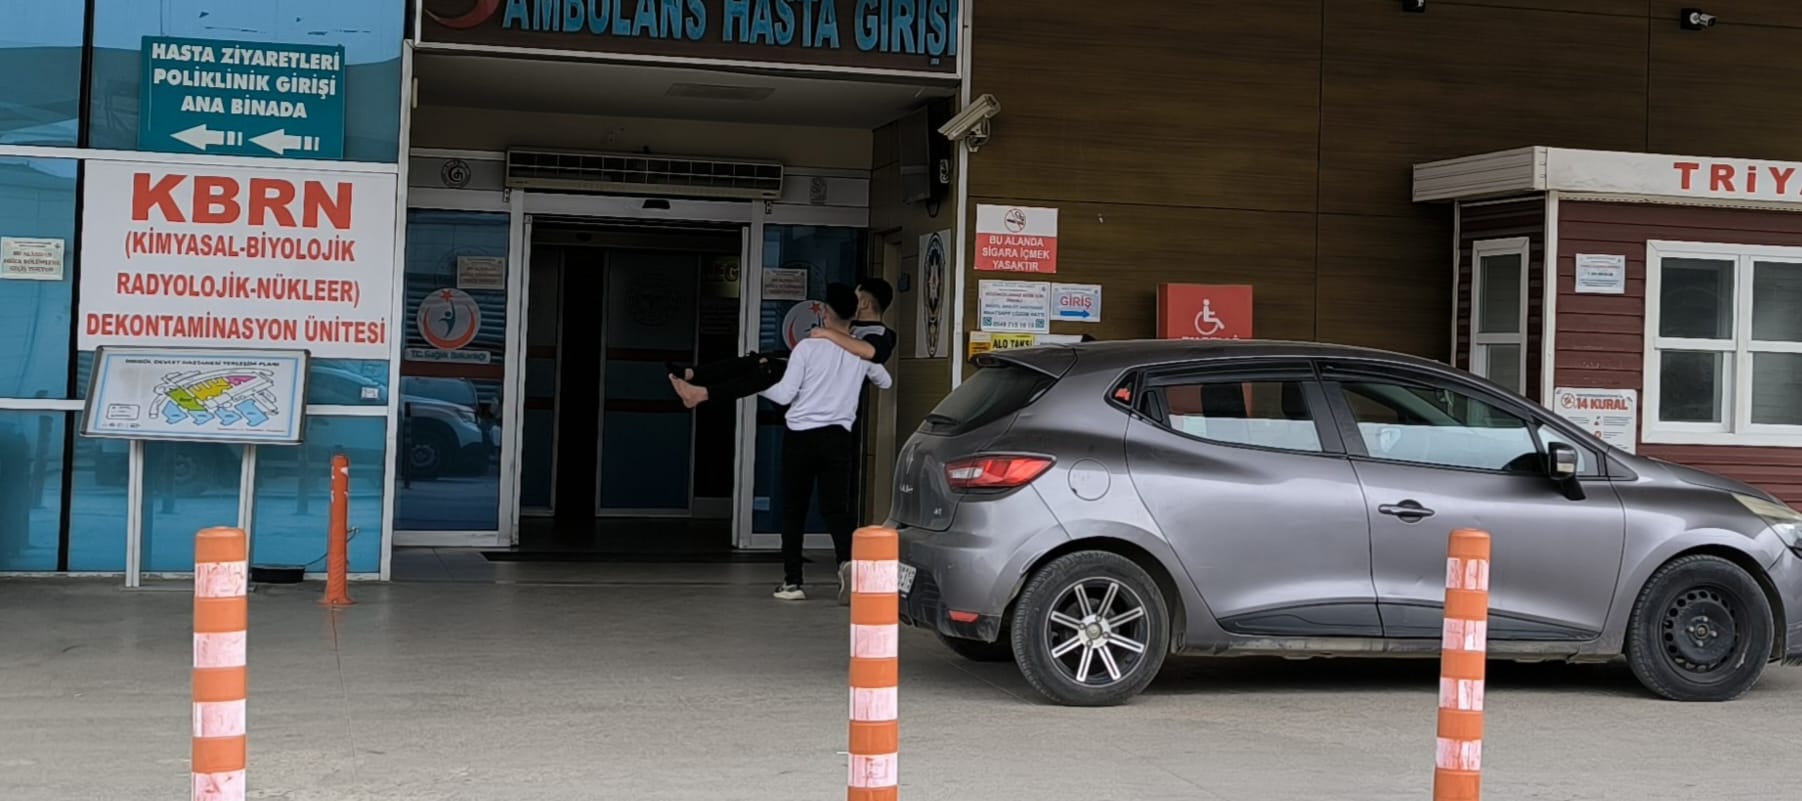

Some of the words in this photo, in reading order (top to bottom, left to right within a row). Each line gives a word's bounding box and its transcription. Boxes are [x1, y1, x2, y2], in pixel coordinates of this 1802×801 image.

[502, 0, 706, 40] AMBULANS
[723, 0, 840, 48] HASTA
[152, 43, 215, 63] HASTA
[220, 44, 340, 71] ZİYARETLERİ
[153, 66, 270, 91] POLİKLİNİK
[276, 73, 336, 99] GİRİŞİ
[181, 96, 225, 114] ANA
[231, 94, 307, 118] BİNADA
[1673, 162, 1802, 195] TRiY
[131, 172, 353, 229] KBRN
[125, 227, 356, 262] (KİMYASAL-BİYOLOJİK
[982, 245, 1018, 258] SİGARA
[1020, 247, 1050, 260] İÇMEK
[989, 235, 1003, 245] BU
[1005, 236, 1044, 247] ALANDA
[992, 260, 1039, 272] YASAKTIR
[117, 271, 360, 308] RADYOLOJİK-NÜKLEER)
[1060, 294, 1092, 309] GİRİŞ
[86, 311, 297, 341] DEKONTAMİNASYON
[304, 315, 386, 344] ÜNİTESİ
[993, 338, 1009, 349] ALO
[1576, 398, 1588, 410] 14
[1590, 398, 1629, 411] KURAL
